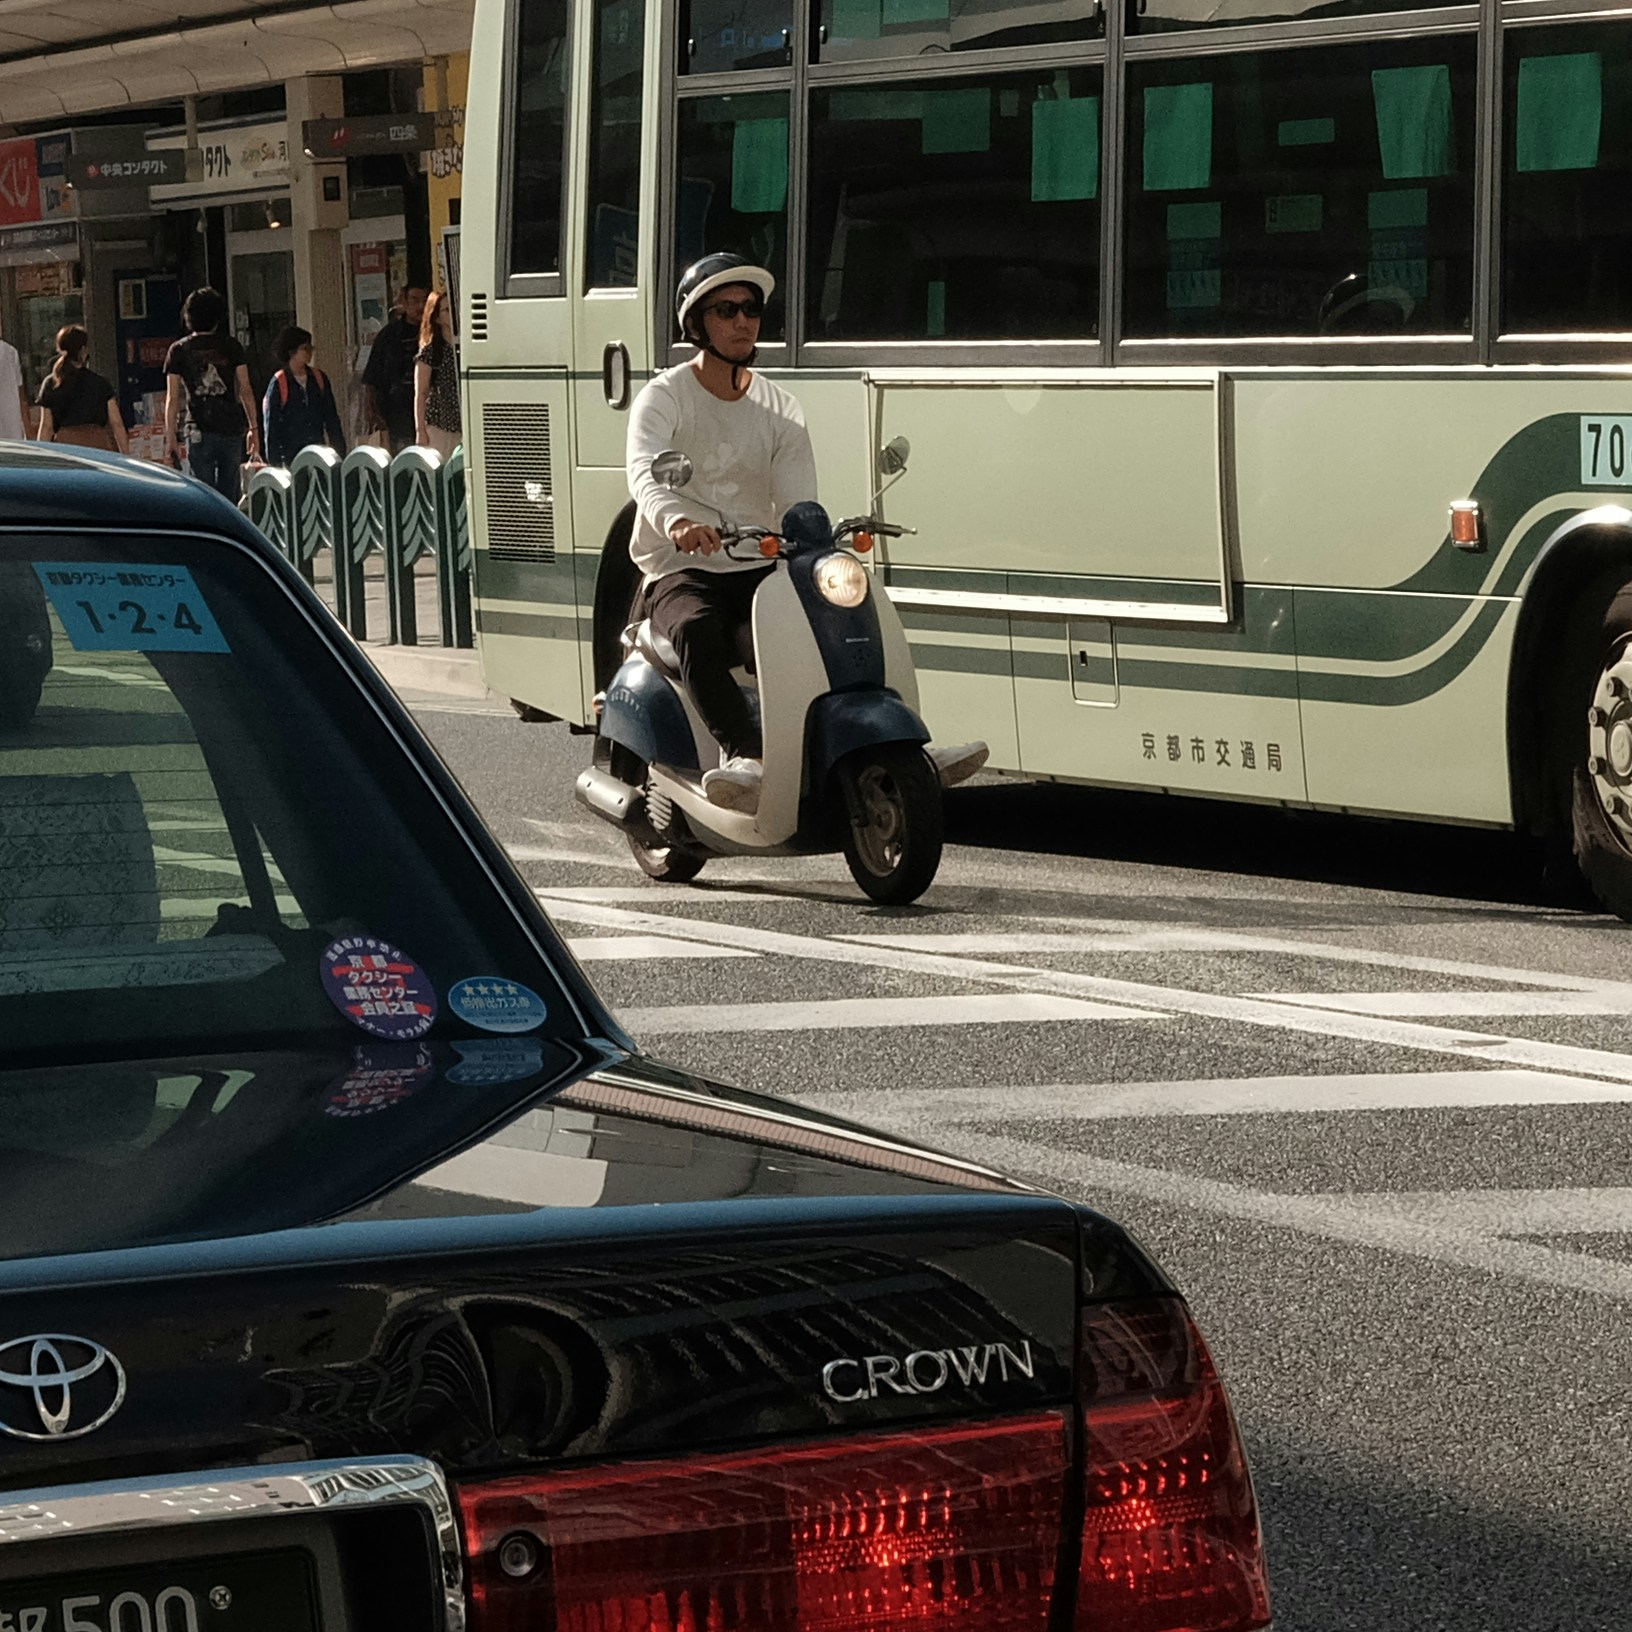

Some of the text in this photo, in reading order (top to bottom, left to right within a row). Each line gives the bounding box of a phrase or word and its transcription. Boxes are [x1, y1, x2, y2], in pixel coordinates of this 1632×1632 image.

[100, 159, 168, 178] 中央コンタクト
[1141, 731, 1283, 772] 京都市交通局
[822, 1340, 1035, 1402] CROWN
